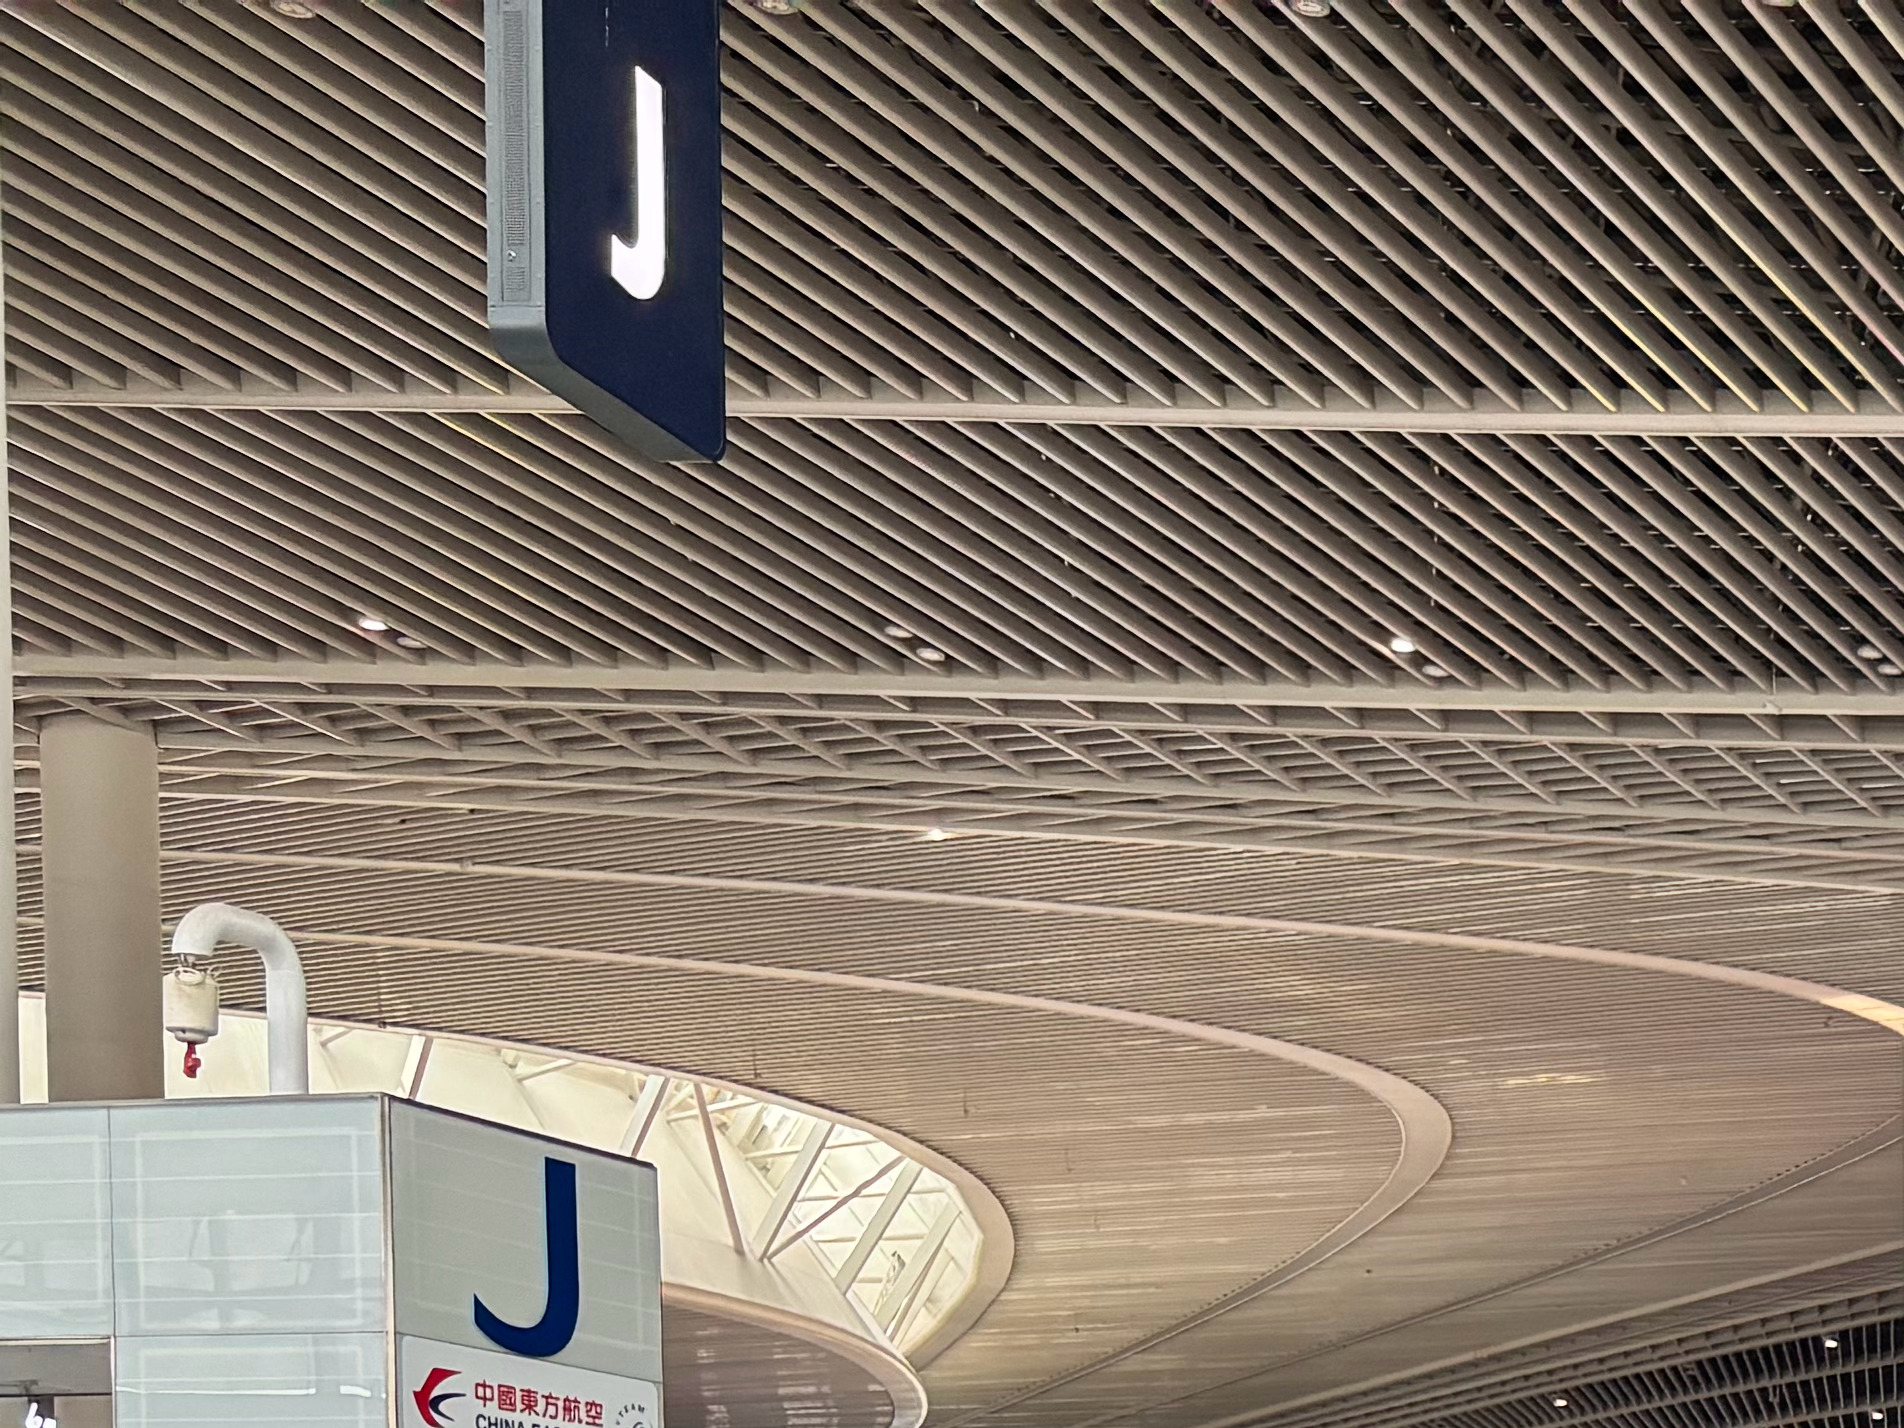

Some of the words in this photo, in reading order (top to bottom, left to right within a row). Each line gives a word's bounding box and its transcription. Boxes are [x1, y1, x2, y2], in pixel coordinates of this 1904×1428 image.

[610, 66, 666, 300] J
[473, 1156, 580, 1358] J
[475, 1379, 605, 1428] 中國東方航空
